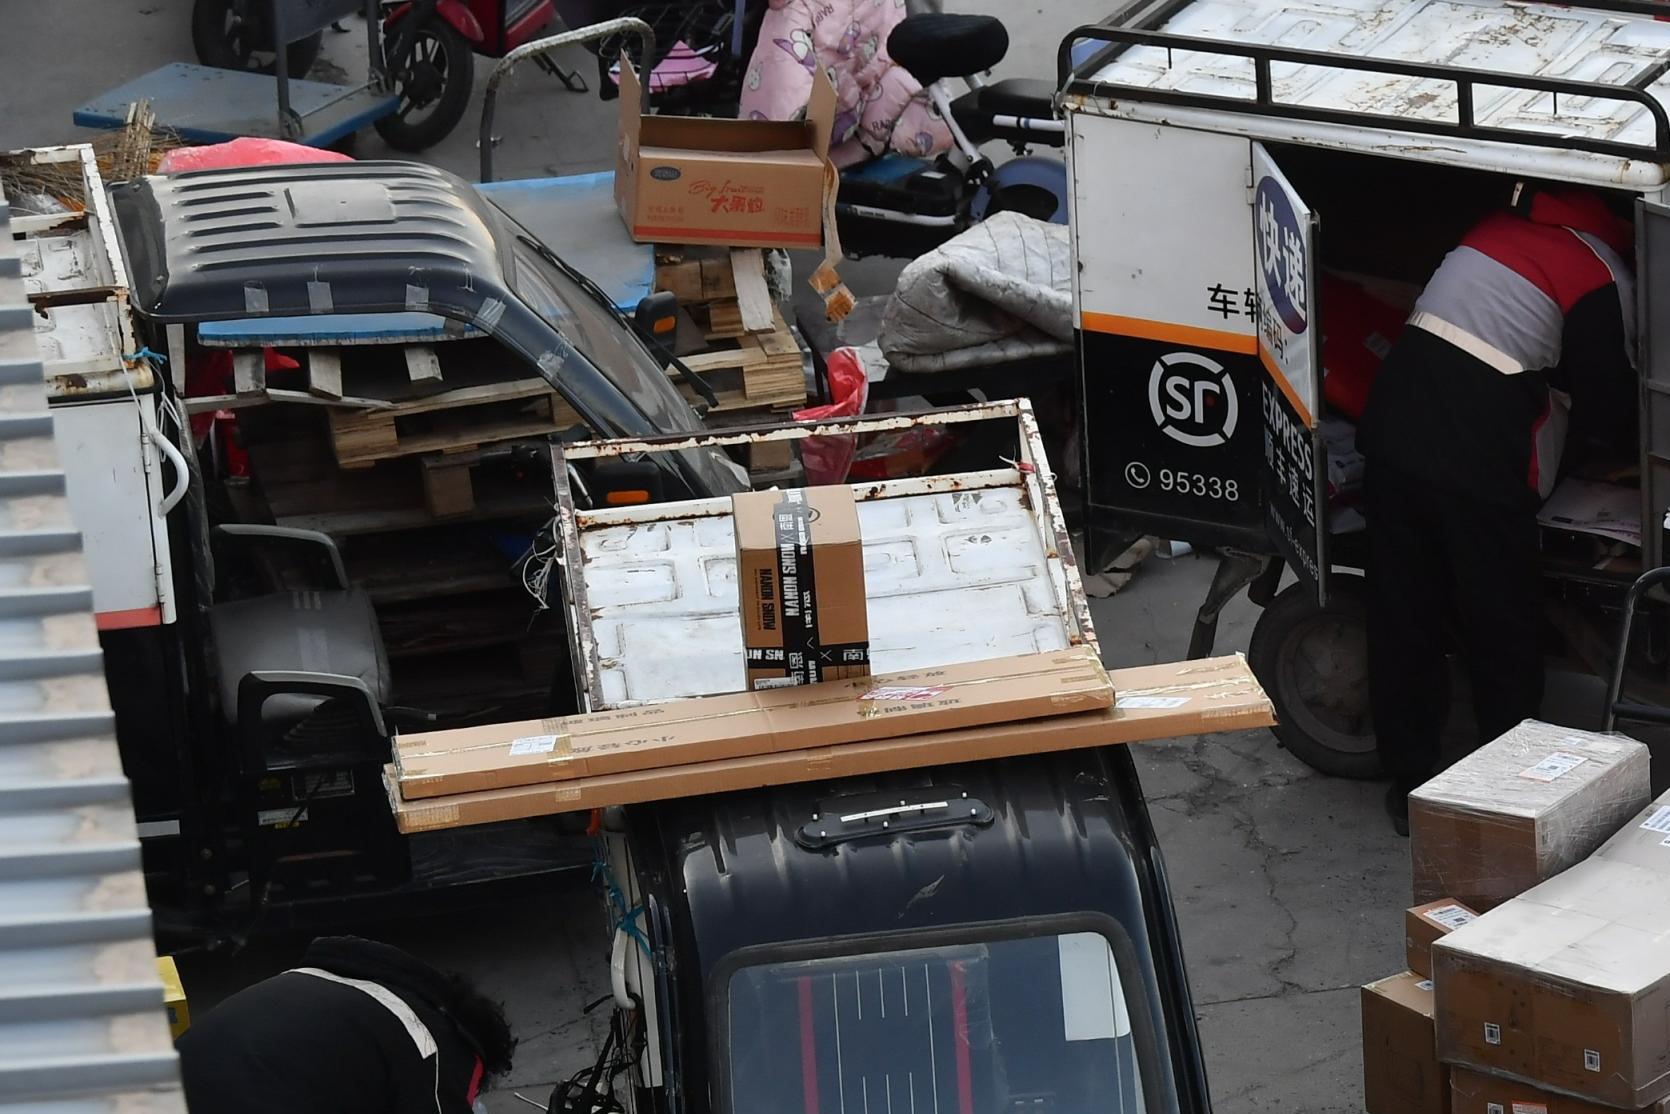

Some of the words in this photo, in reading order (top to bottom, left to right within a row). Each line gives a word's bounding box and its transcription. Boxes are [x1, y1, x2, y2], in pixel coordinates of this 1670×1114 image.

[1259, 190, 1307, 320] 快递
[1262, 381, 1314, 481] EXPRESS
[1159, 468, 1239, 501] 95338
